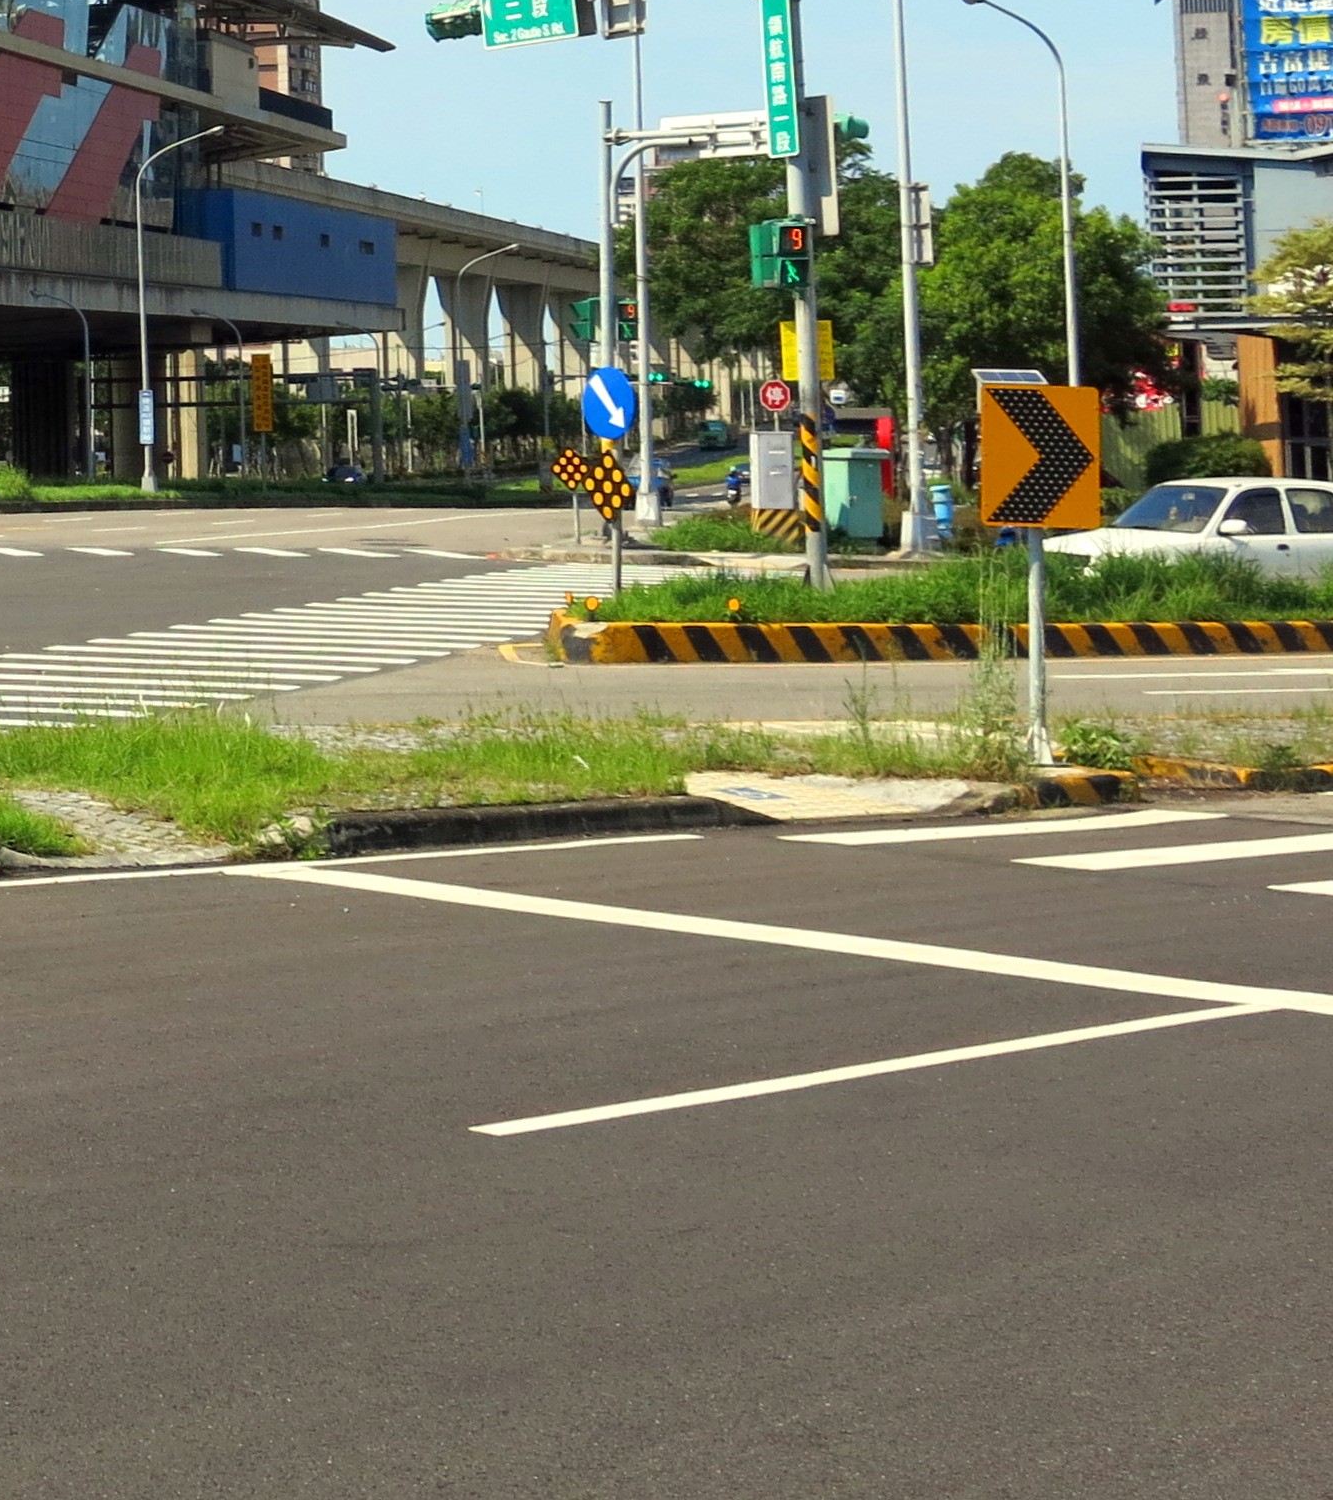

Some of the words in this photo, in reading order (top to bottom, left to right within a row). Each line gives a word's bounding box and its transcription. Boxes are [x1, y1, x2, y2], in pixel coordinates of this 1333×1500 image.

[1260, 15, 1332, 45] 房價
[767, 15, 792, 153] 領航南路一段
[765, 386, 785, 406] 停
